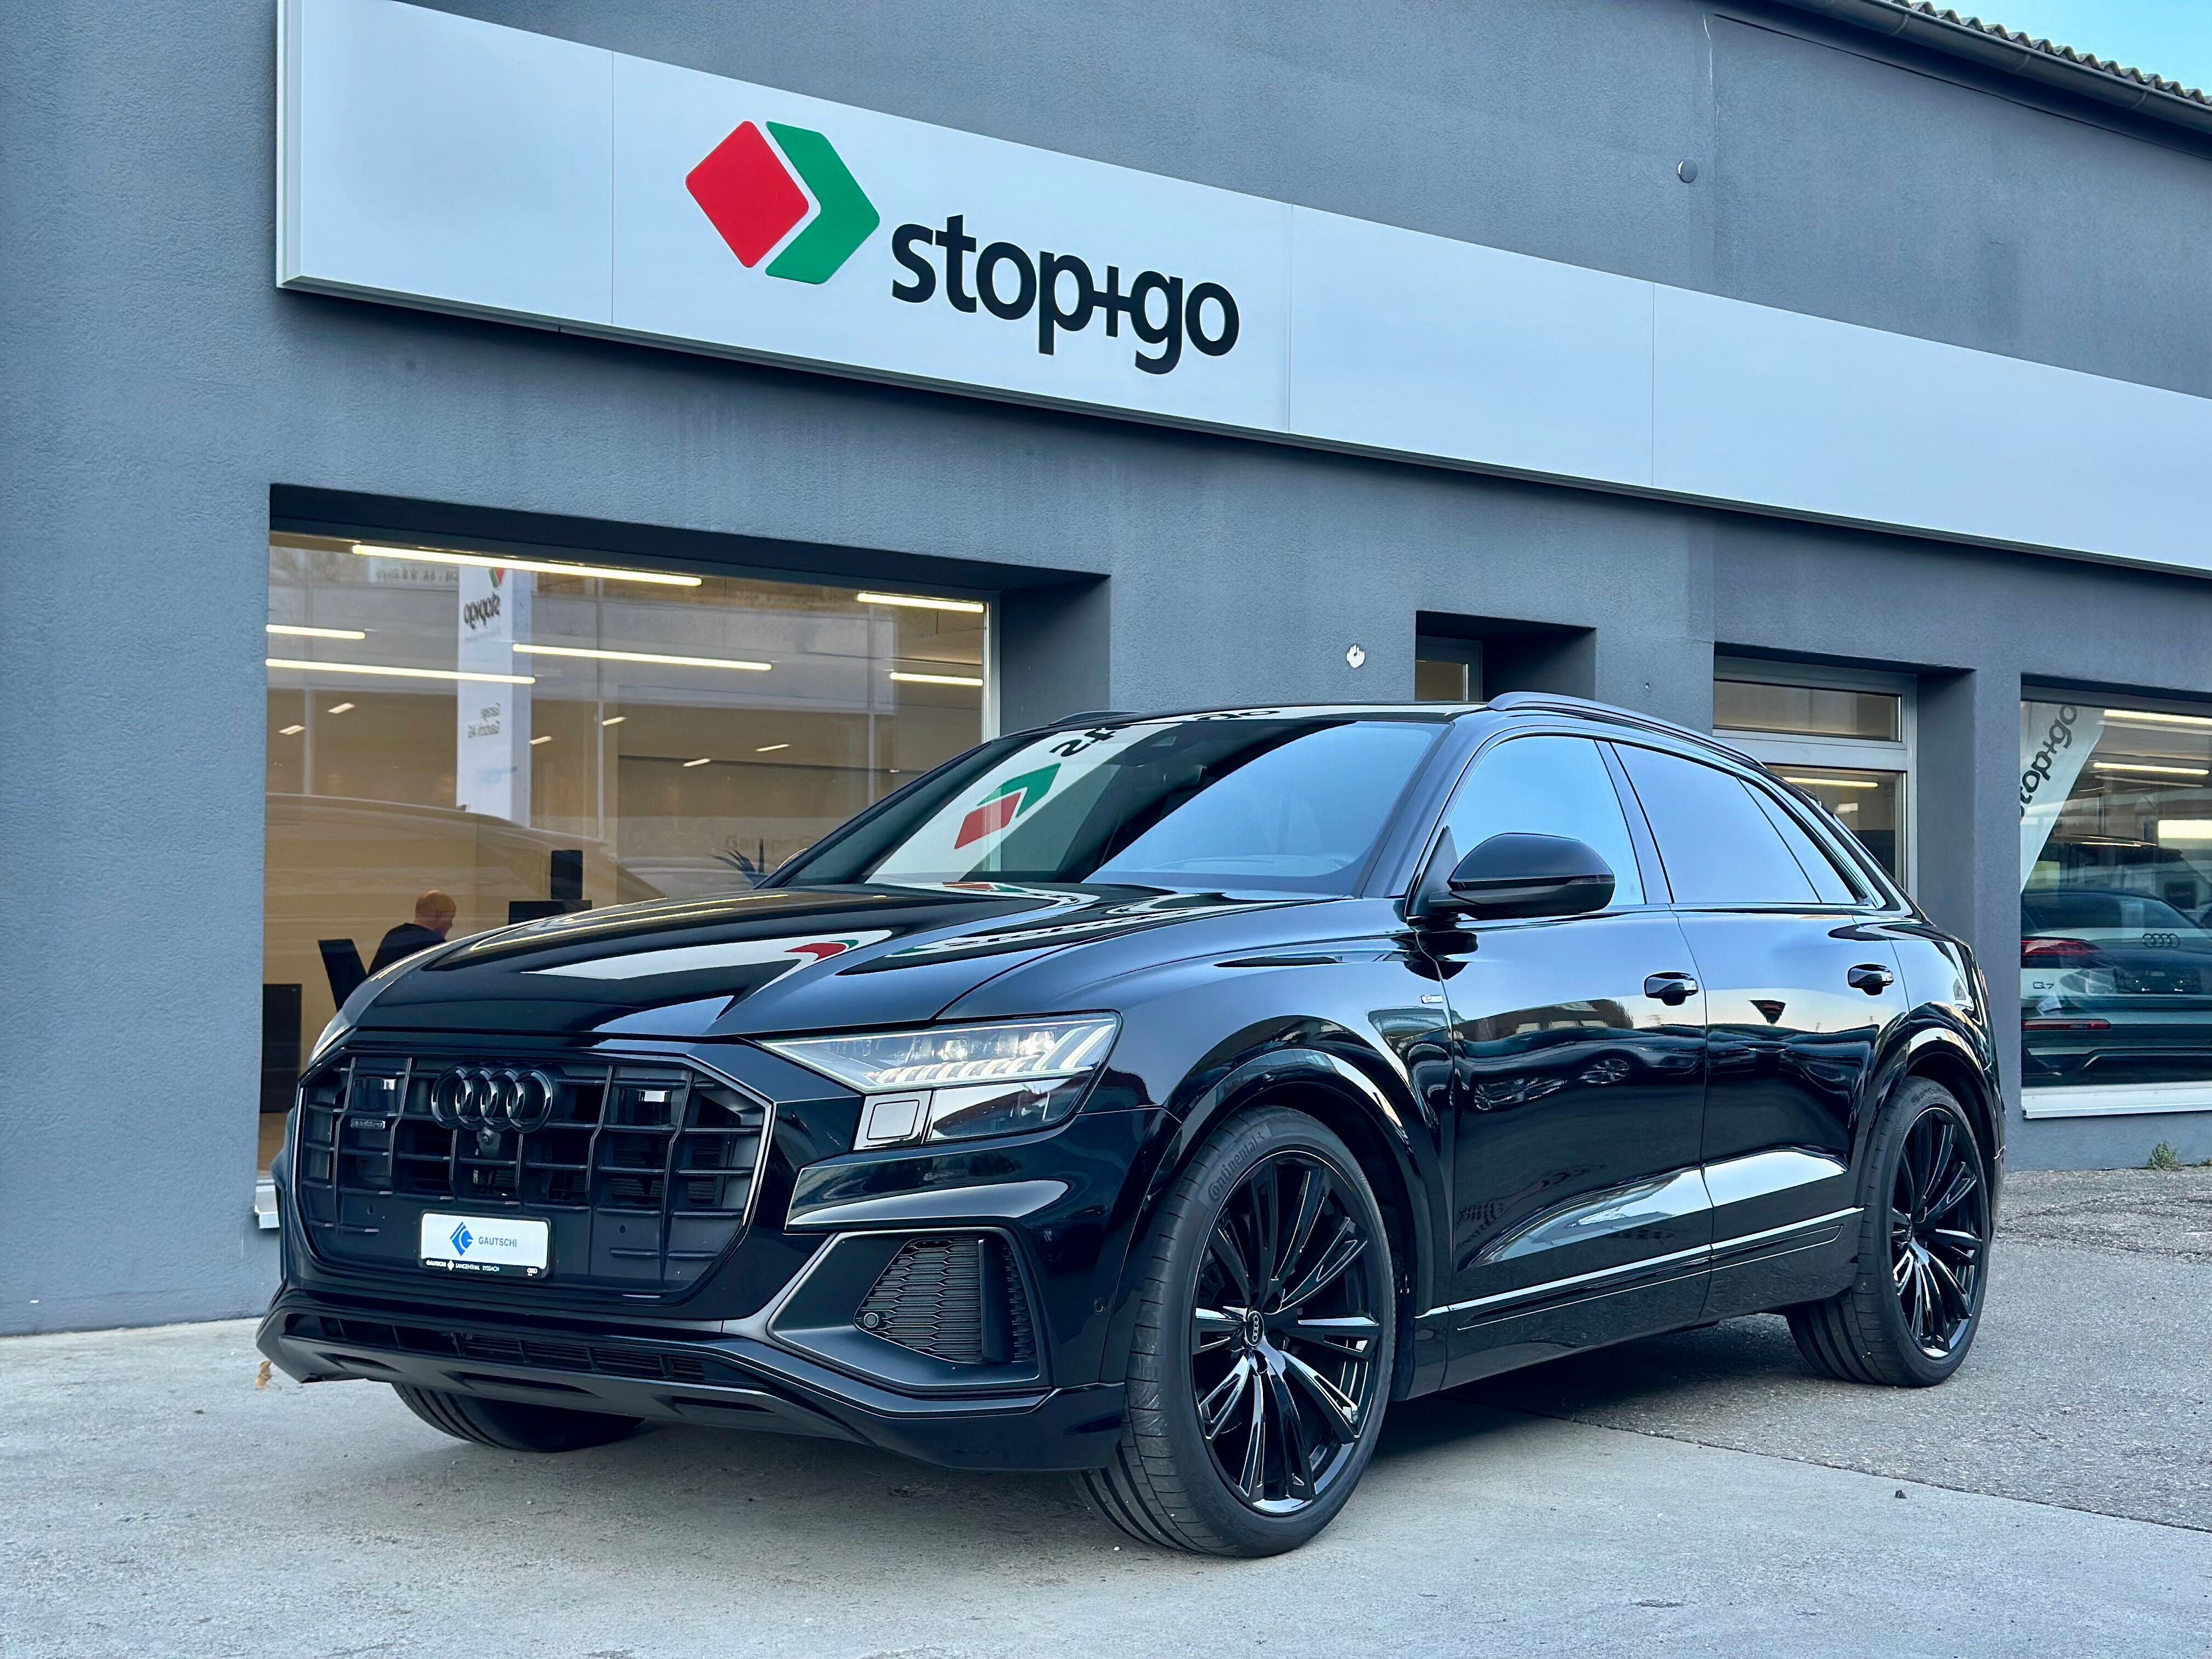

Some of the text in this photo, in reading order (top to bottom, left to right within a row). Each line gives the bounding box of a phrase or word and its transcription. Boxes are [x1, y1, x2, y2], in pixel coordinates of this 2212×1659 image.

[891, 215, 1239, 374] stop+go
[2033, 981, 2055, 990] Q7
[1208, 1137, 1259, 1202] Continental
[479, 1237, 517, 1247] GAUTSCHI
